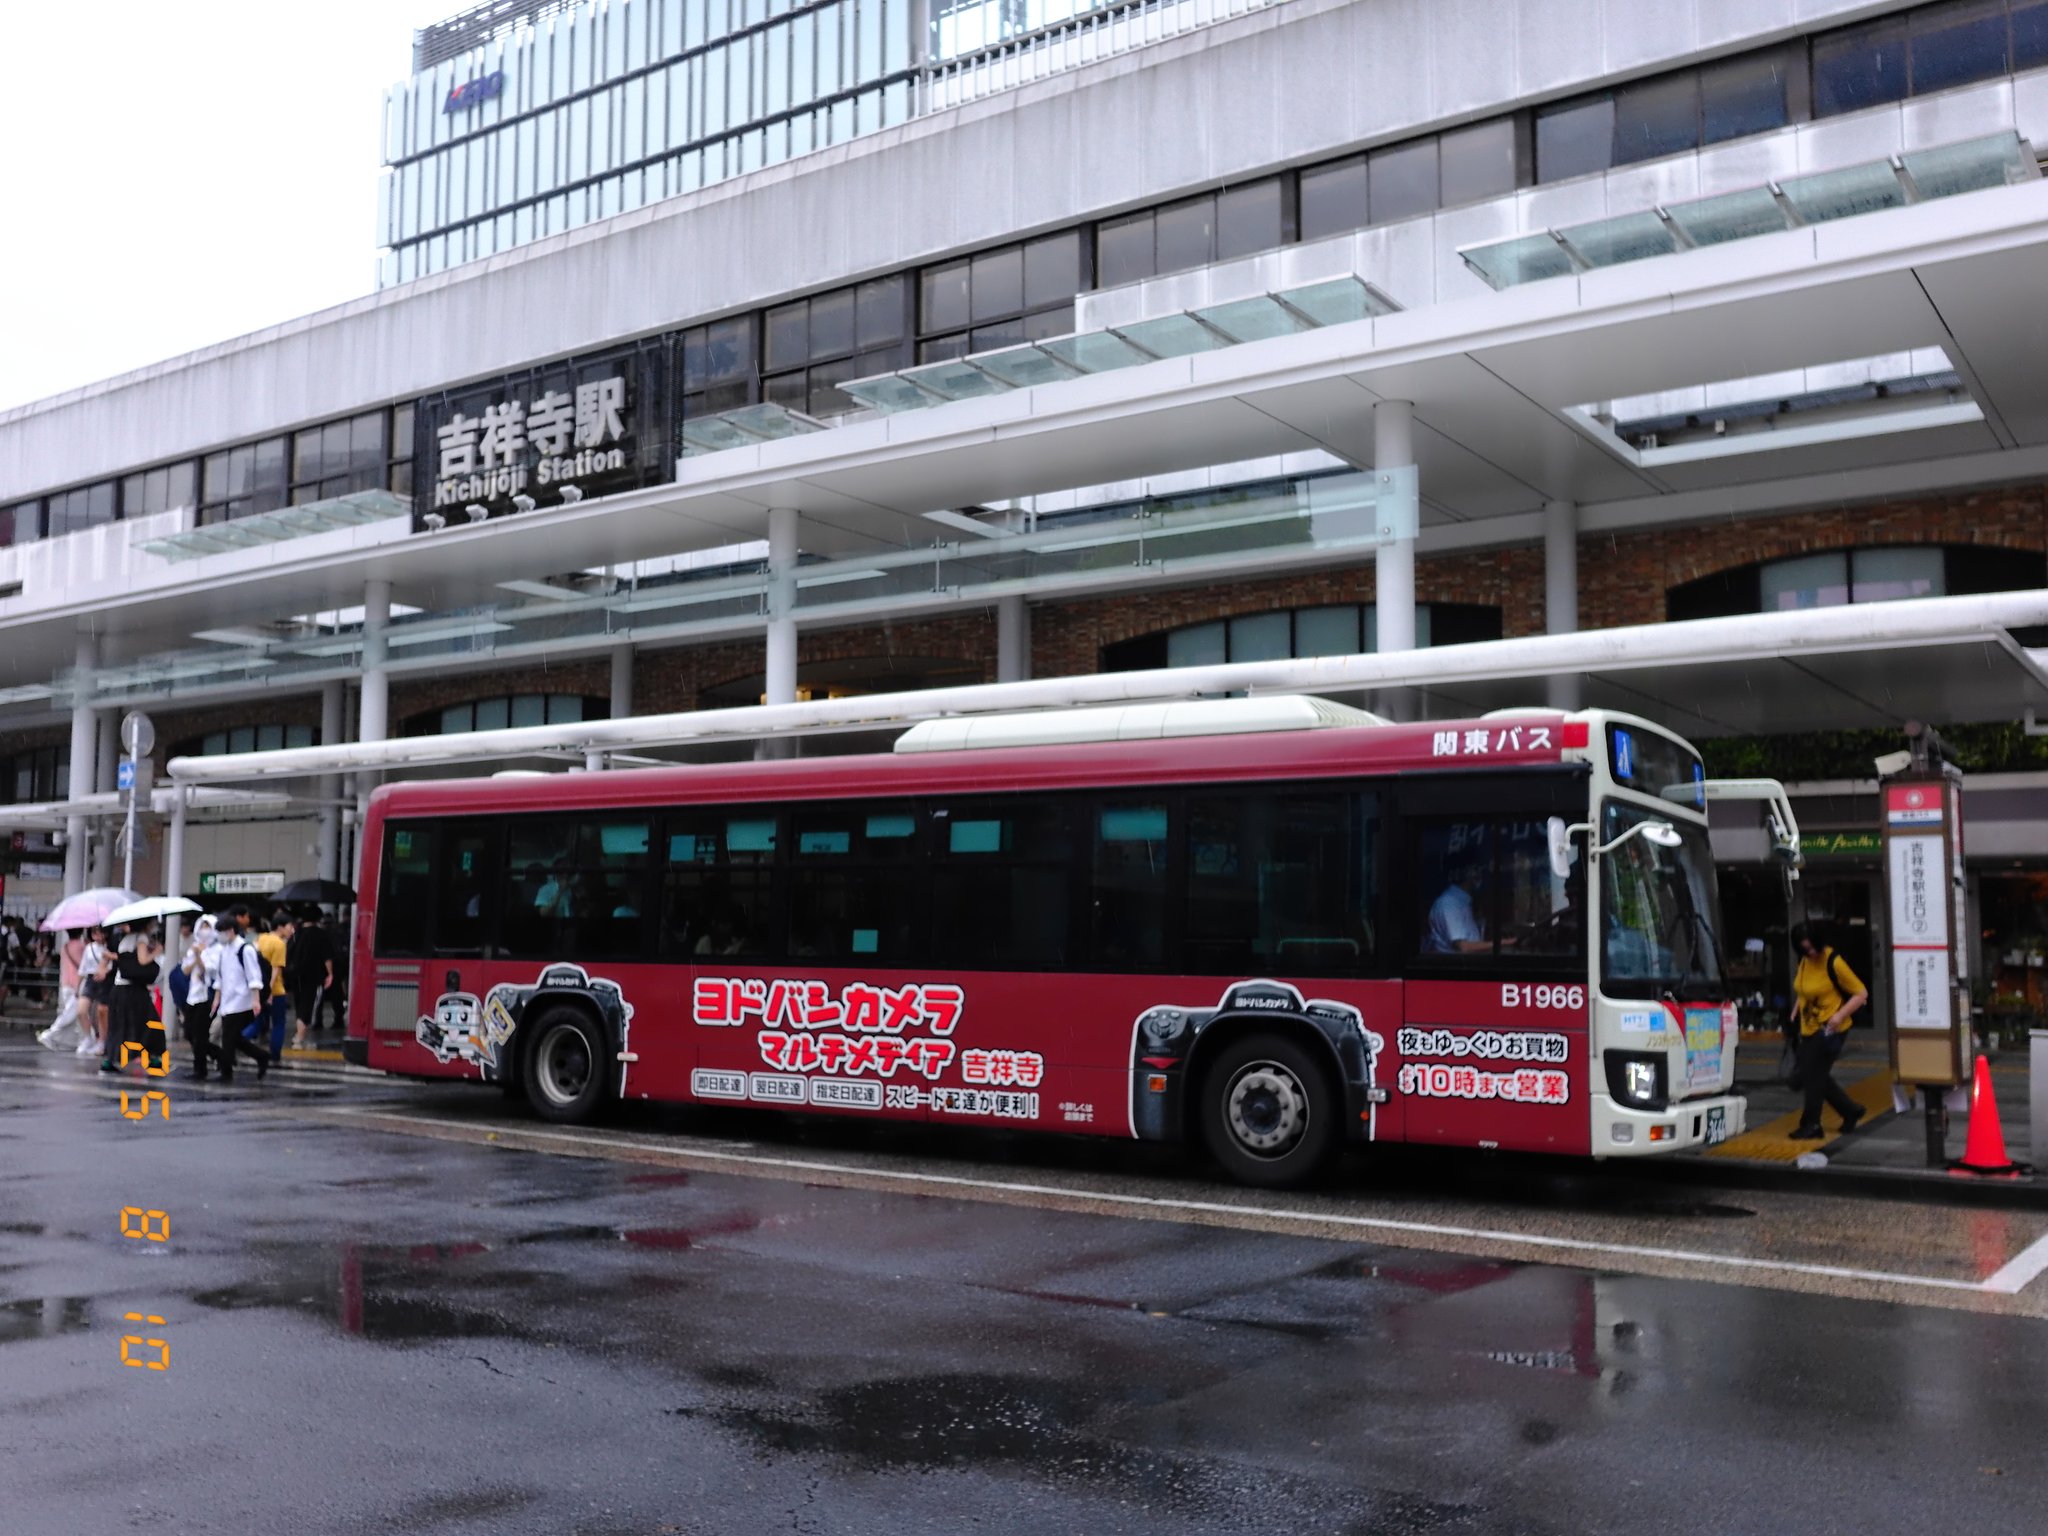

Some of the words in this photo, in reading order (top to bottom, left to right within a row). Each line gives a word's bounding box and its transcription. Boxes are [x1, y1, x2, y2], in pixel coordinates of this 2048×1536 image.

[437, 376, 626, 481] 吉祥寺駅
[537, 448, 626, 486] Station
[1433, 725, 1552, 757] 関東バス
[694, 978, 963, 1034] ヨドバシカメラ
[1501, 984, 1584, 1010] B1966
[758, 1032, 954, 1078] マルチメディア
[1399, 1029, 1568, 1061] 夜もゆっくりお買物
[962, 1049, 1044, 1087] 吉祥寺
[698, 1077, 742, 1093] 即日配達
[755, 1081, 802, 1098] 翌日配達
[816, 1083, 877, 1104] 指定日配達
